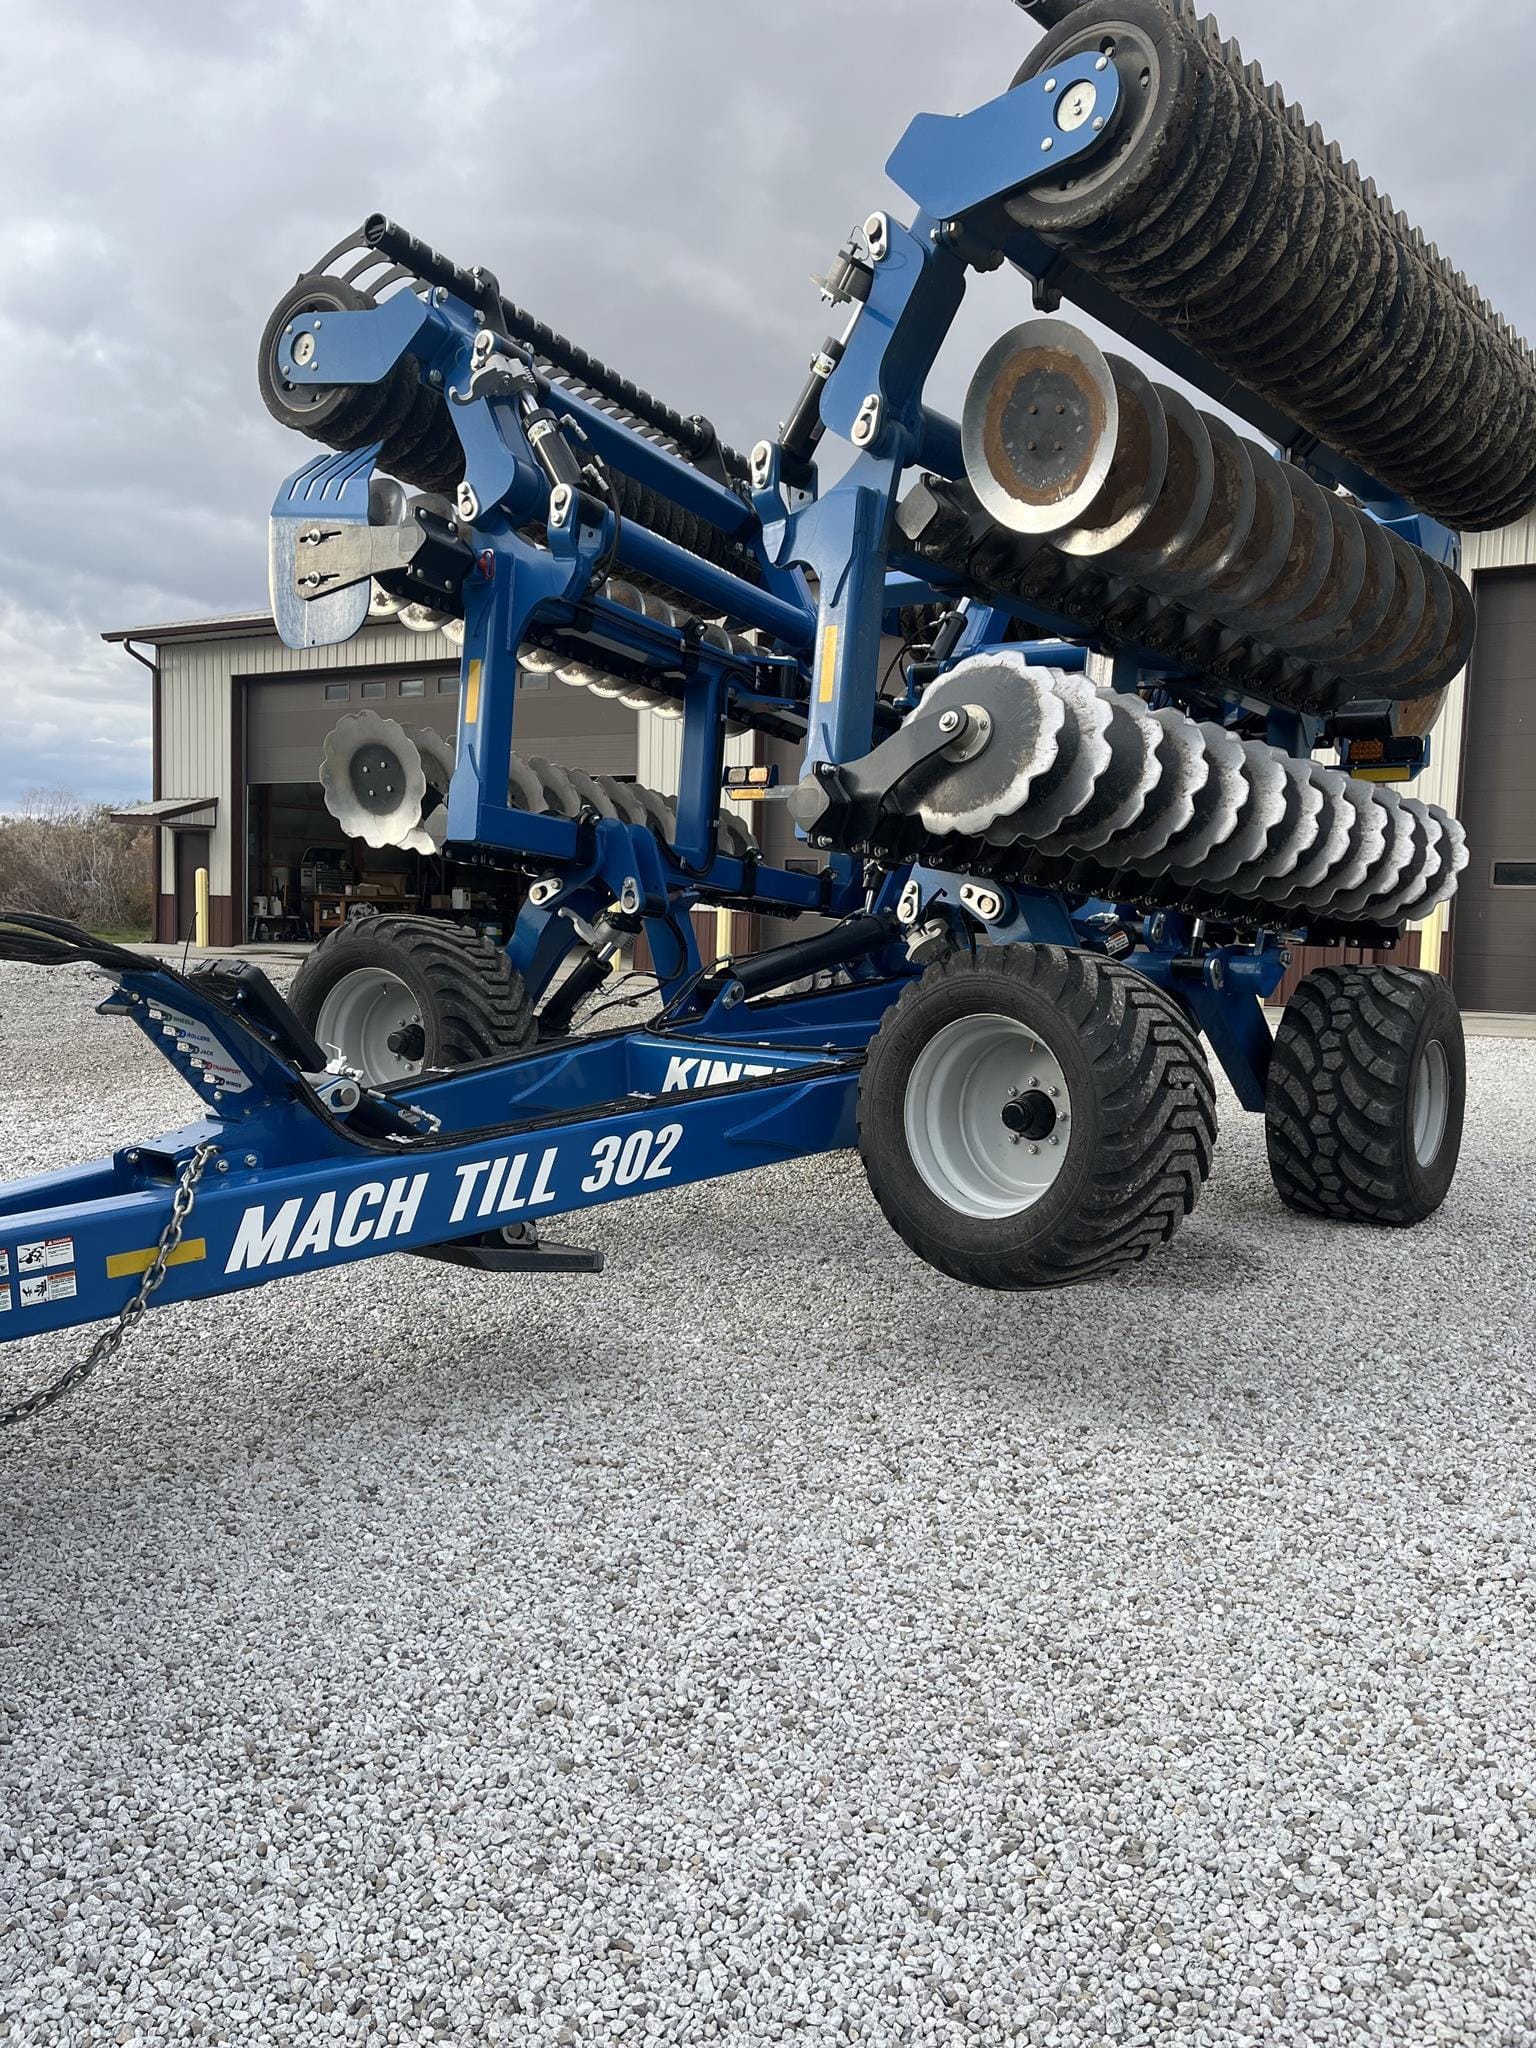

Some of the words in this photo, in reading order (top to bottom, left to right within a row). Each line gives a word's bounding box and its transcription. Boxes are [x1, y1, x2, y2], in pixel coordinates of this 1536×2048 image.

[186, 1032, 211, 1043] ROLLERS
[199, 1048, 214, 1057] JACK
[212, 1063, 242, 1076] TRANSPORT
[661, 1056, 791, 1094] KIN
[225, 1080, 242, 1089] WINGS
[224, 1172, 430, 1274] MACH
[449, 1147, 559, 1223] TILL
[581, 1123, 683, 1193] 302
